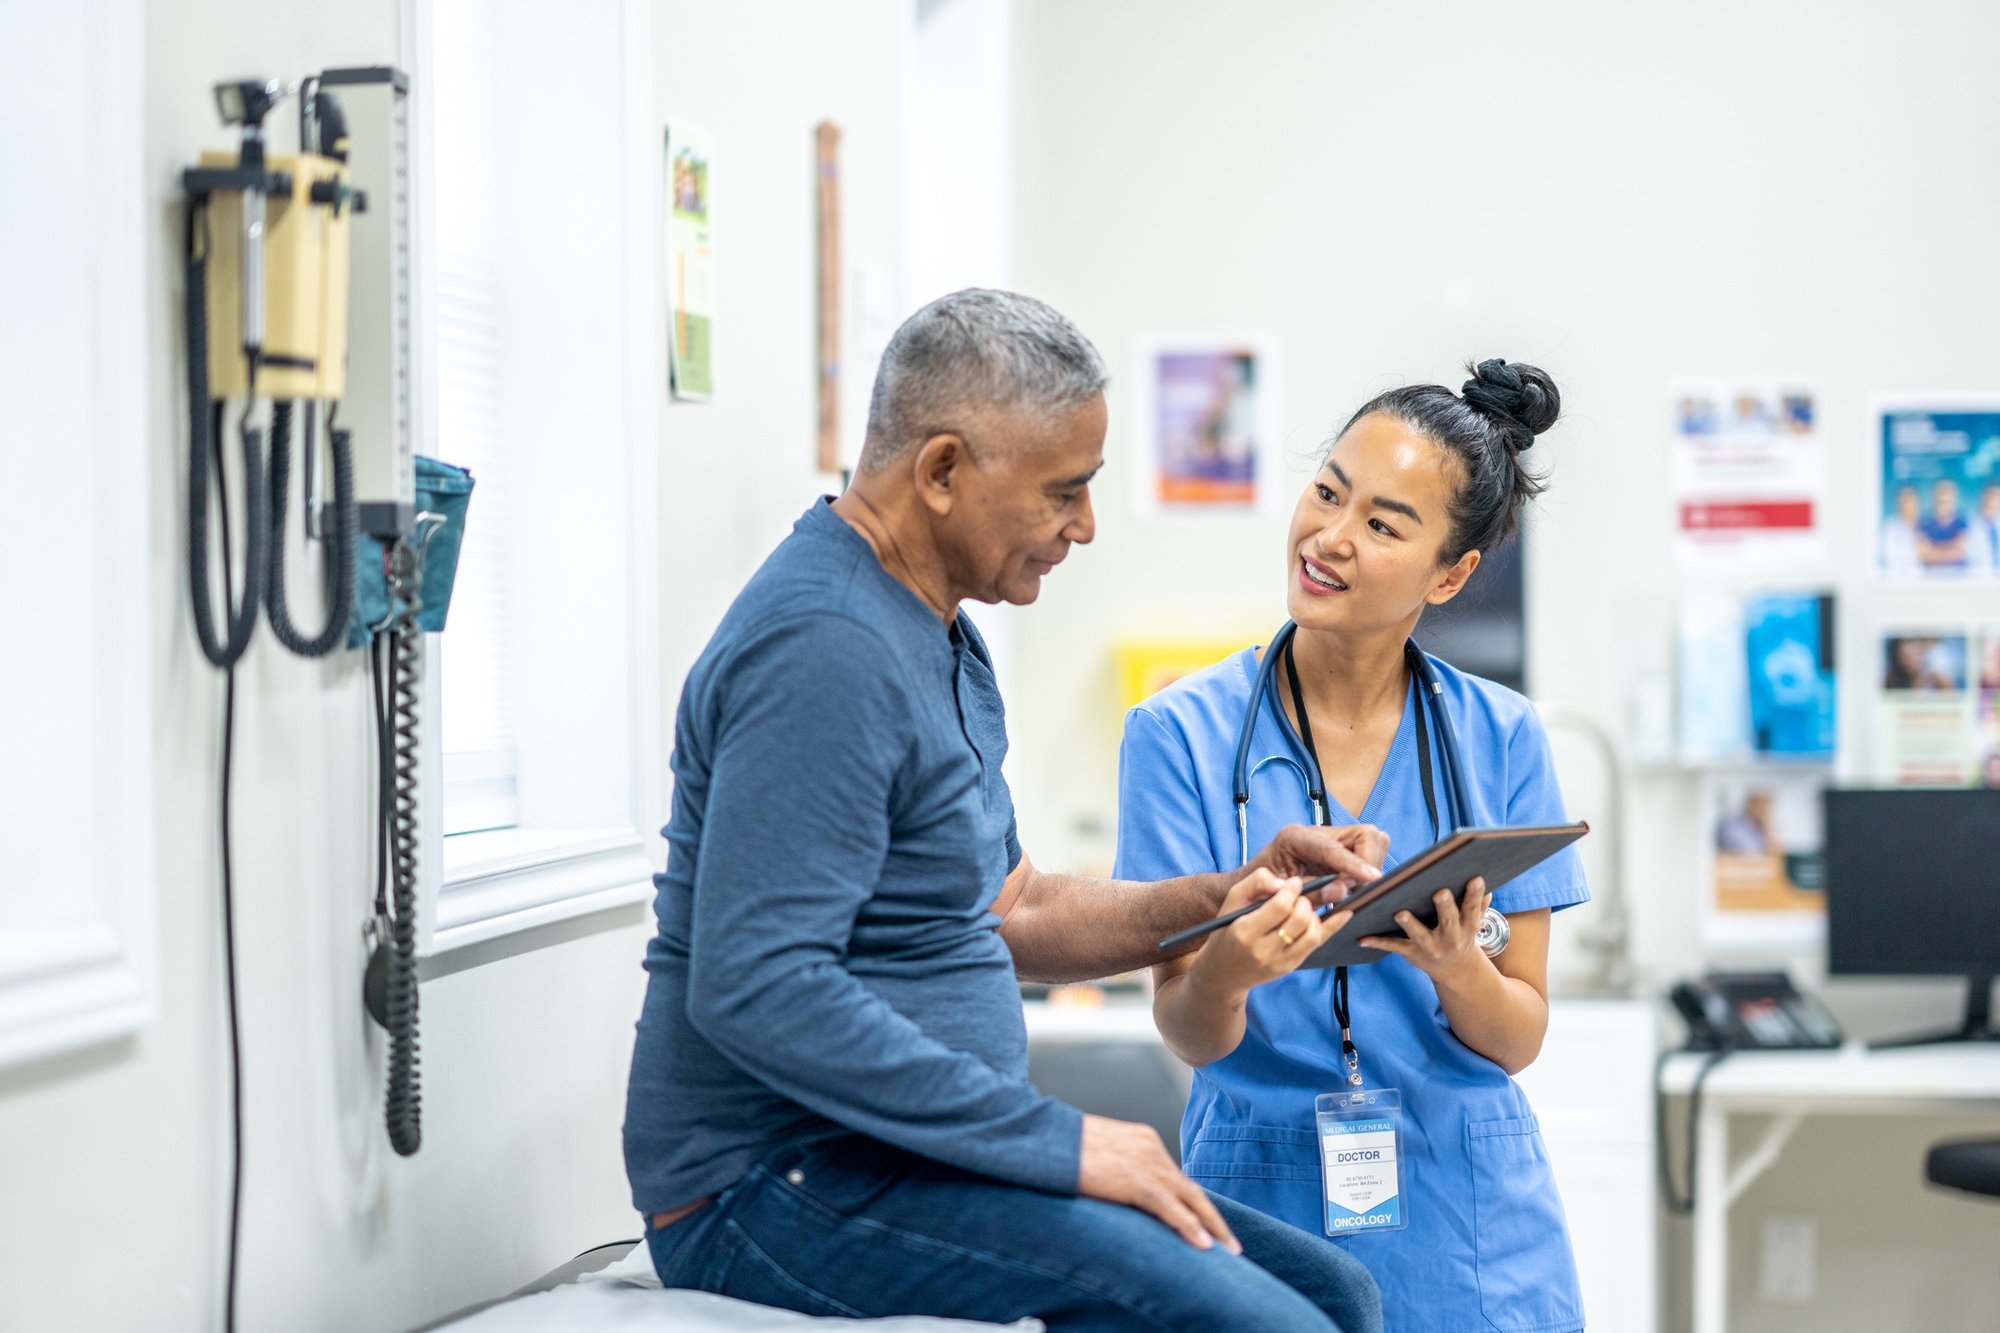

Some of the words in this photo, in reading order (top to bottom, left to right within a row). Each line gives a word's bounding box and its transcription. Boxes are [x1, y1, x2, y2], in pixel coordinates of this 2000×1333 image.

[1325, 1125, 1356, 1134] MEDICAL
[1358, 1123, 1391, 1132] GENERAL
[1338, 1151, 1380, 1162] DOCTOR
[1334, 1213, 1392, 1228] ONCOLOGY
